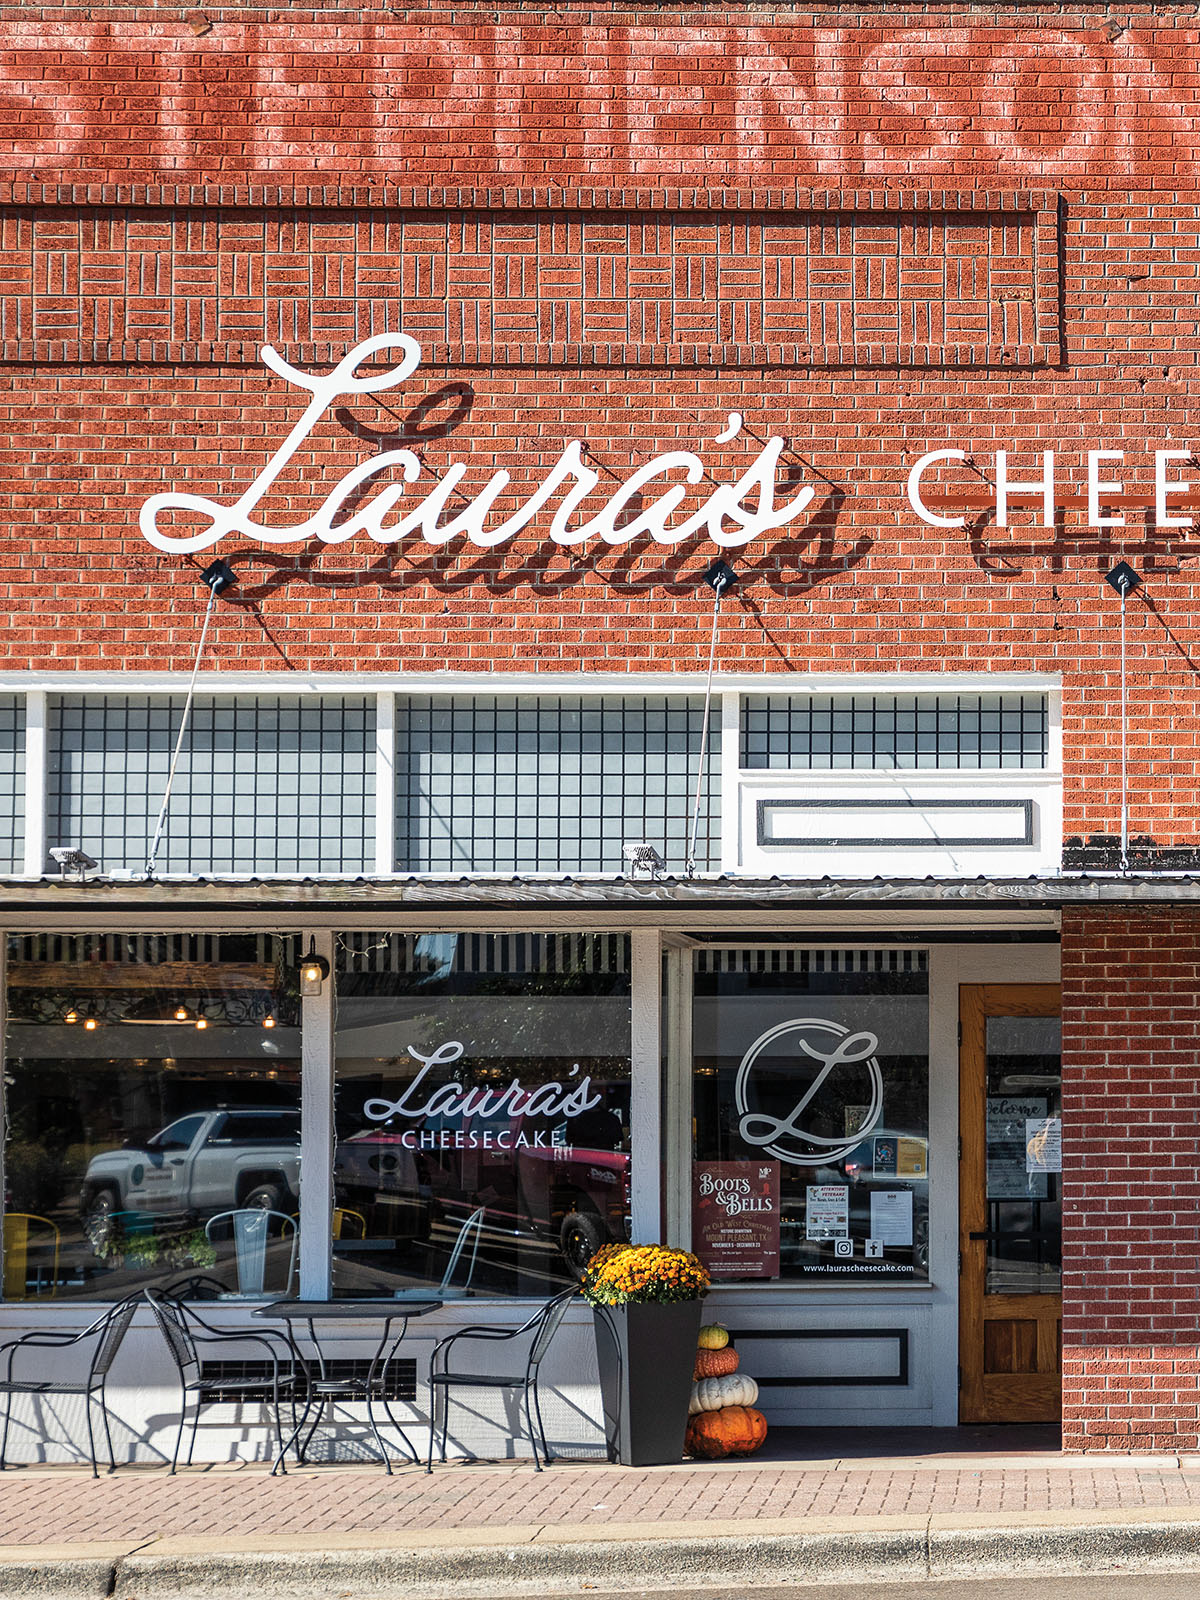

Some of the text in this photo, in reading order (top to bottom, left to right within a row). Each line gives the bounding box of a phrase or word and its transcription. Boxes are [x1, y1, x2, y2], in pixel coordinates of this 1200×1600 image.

[139, 332, 815, 554] Laura's
[364, 1041, 602, 1120] Laura's
[401, 1130, 560, 1149] CHEESECAKE
[699, 1173, 751, 1195] BOOTS
[715, 1191, 773, 1216] & BELLS
[803, 1264, 914, 1273] www.laurascheesecake.com
